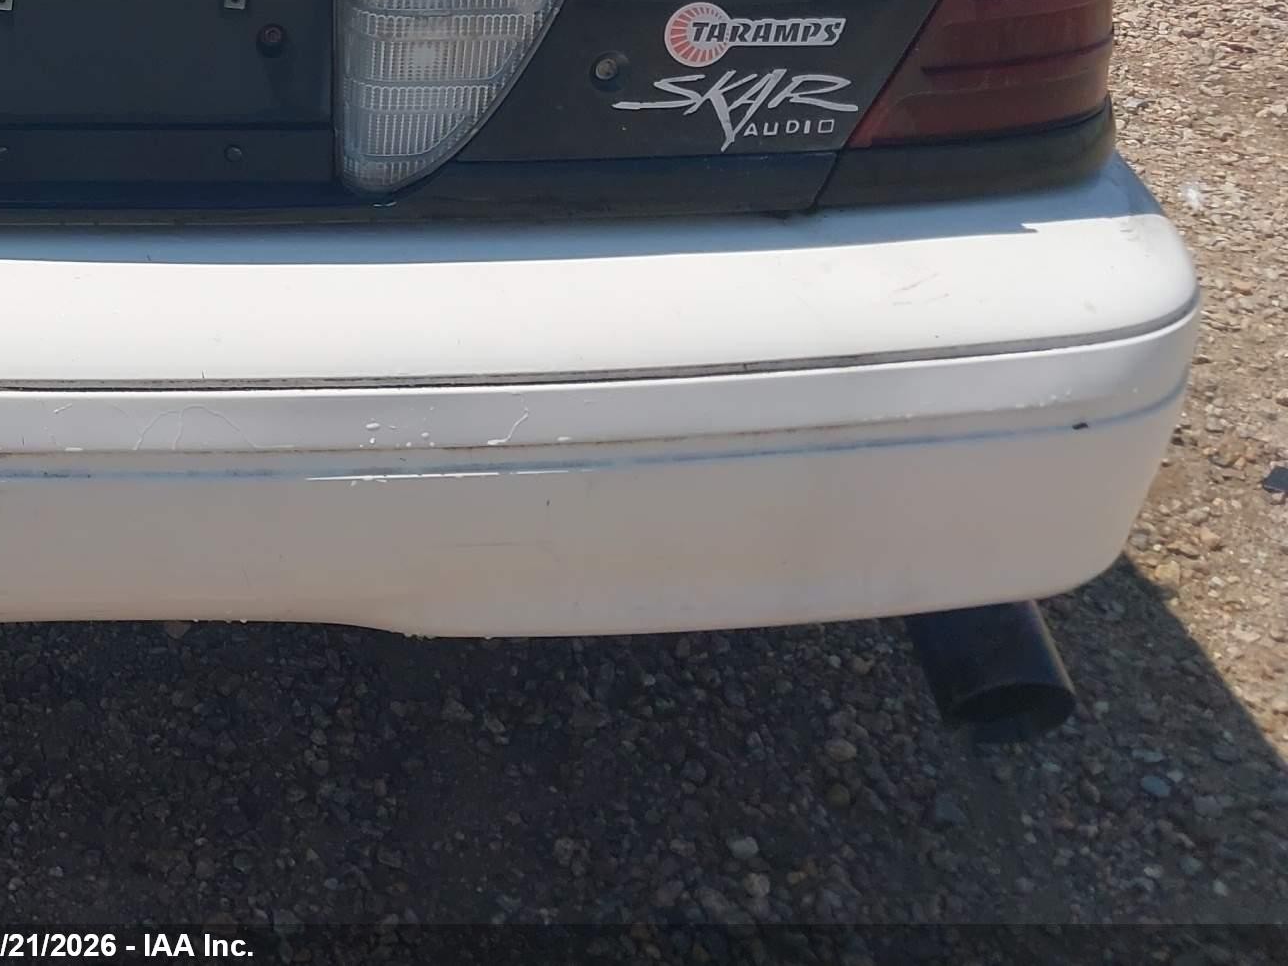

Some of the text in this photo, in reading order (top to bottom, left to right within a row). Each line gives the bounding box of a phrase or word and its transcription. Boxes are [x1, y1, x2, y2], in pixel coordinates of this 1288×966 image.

[691, 21, 841, 43] TARAMPS
[611, 68, 859, 152] SKAR
[743, 119, 835, 136] AUDIO
